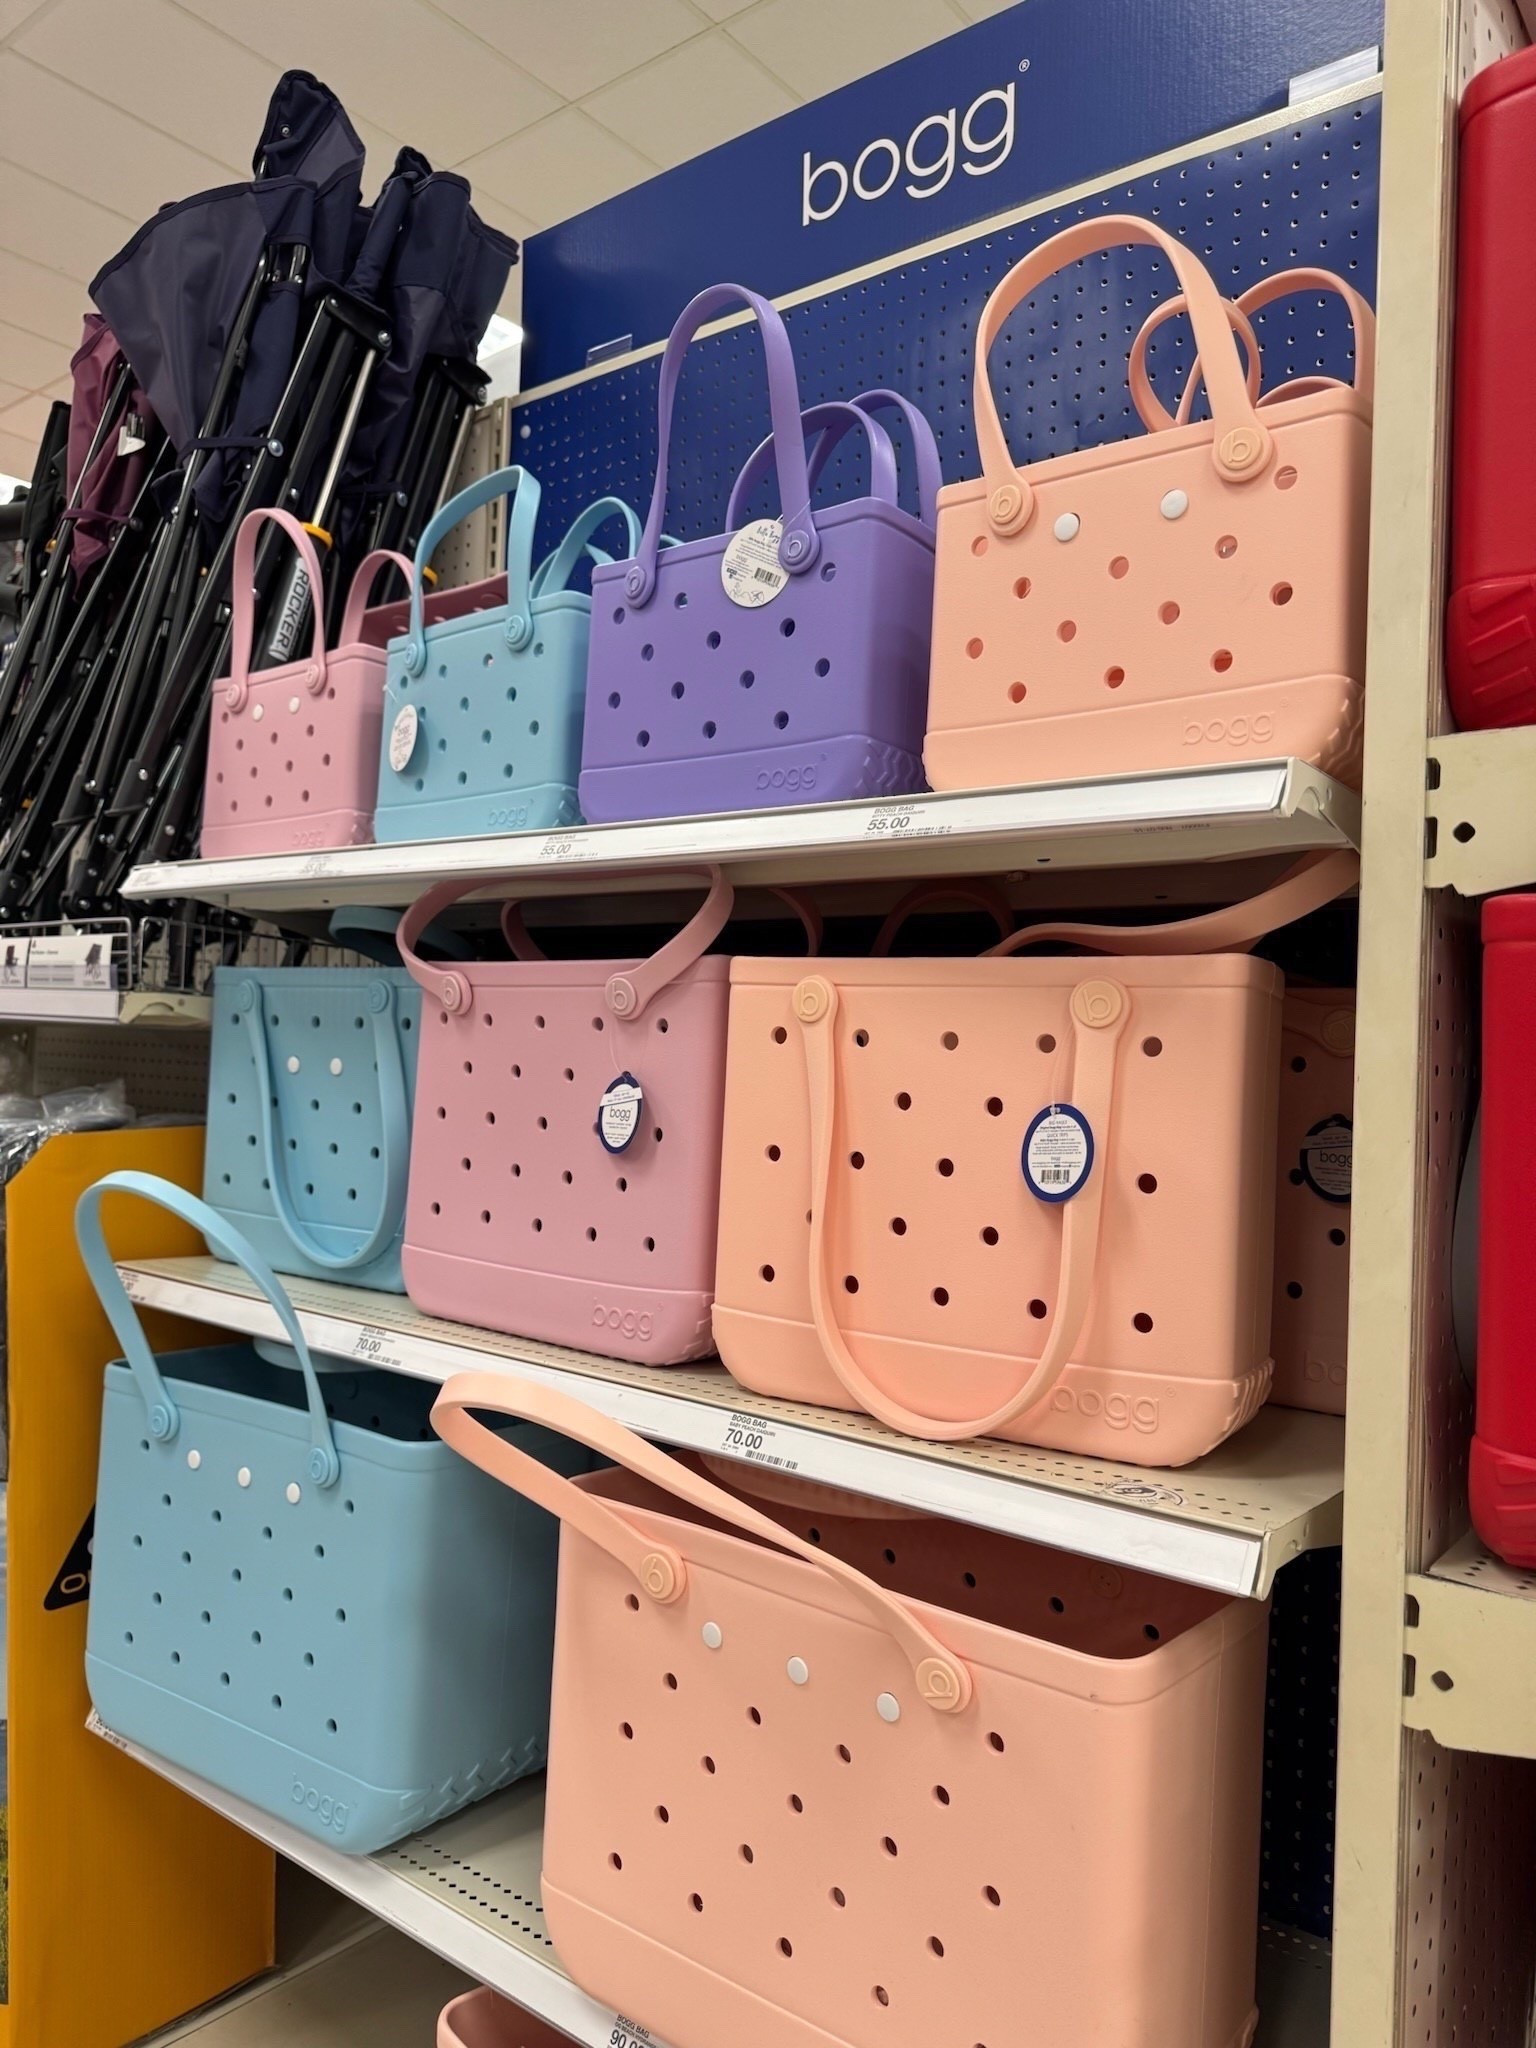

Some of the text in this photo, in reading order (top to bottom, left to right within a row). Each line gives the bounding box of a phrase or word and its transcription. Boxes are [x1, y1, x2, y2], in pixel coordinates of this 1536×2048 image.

[276, 568, 311, 649] ROCKER
[1182, 711, 1275, 747] bogg
[756, 764, 817, 792] bogg
[867, 816, 910, 831] 55.00
[540, 843, 572, 856] 55.00
[609, 1106, 631, 1122] bogg
[592, 1296, 654, 1342] bogg
[355, 1337, 382, 1353] 70.00
[1304, 1352, 1346, 1385] bo
[732, 1414, 768, 1429] BOGG BAG
[741, 1424, 757, 1433] PEACH
[725, 1428, 763, 1449] 70.00
[292, 1772, 350, 1835] bogg
[617, 2014, 650, 2039] BOGG BAG
